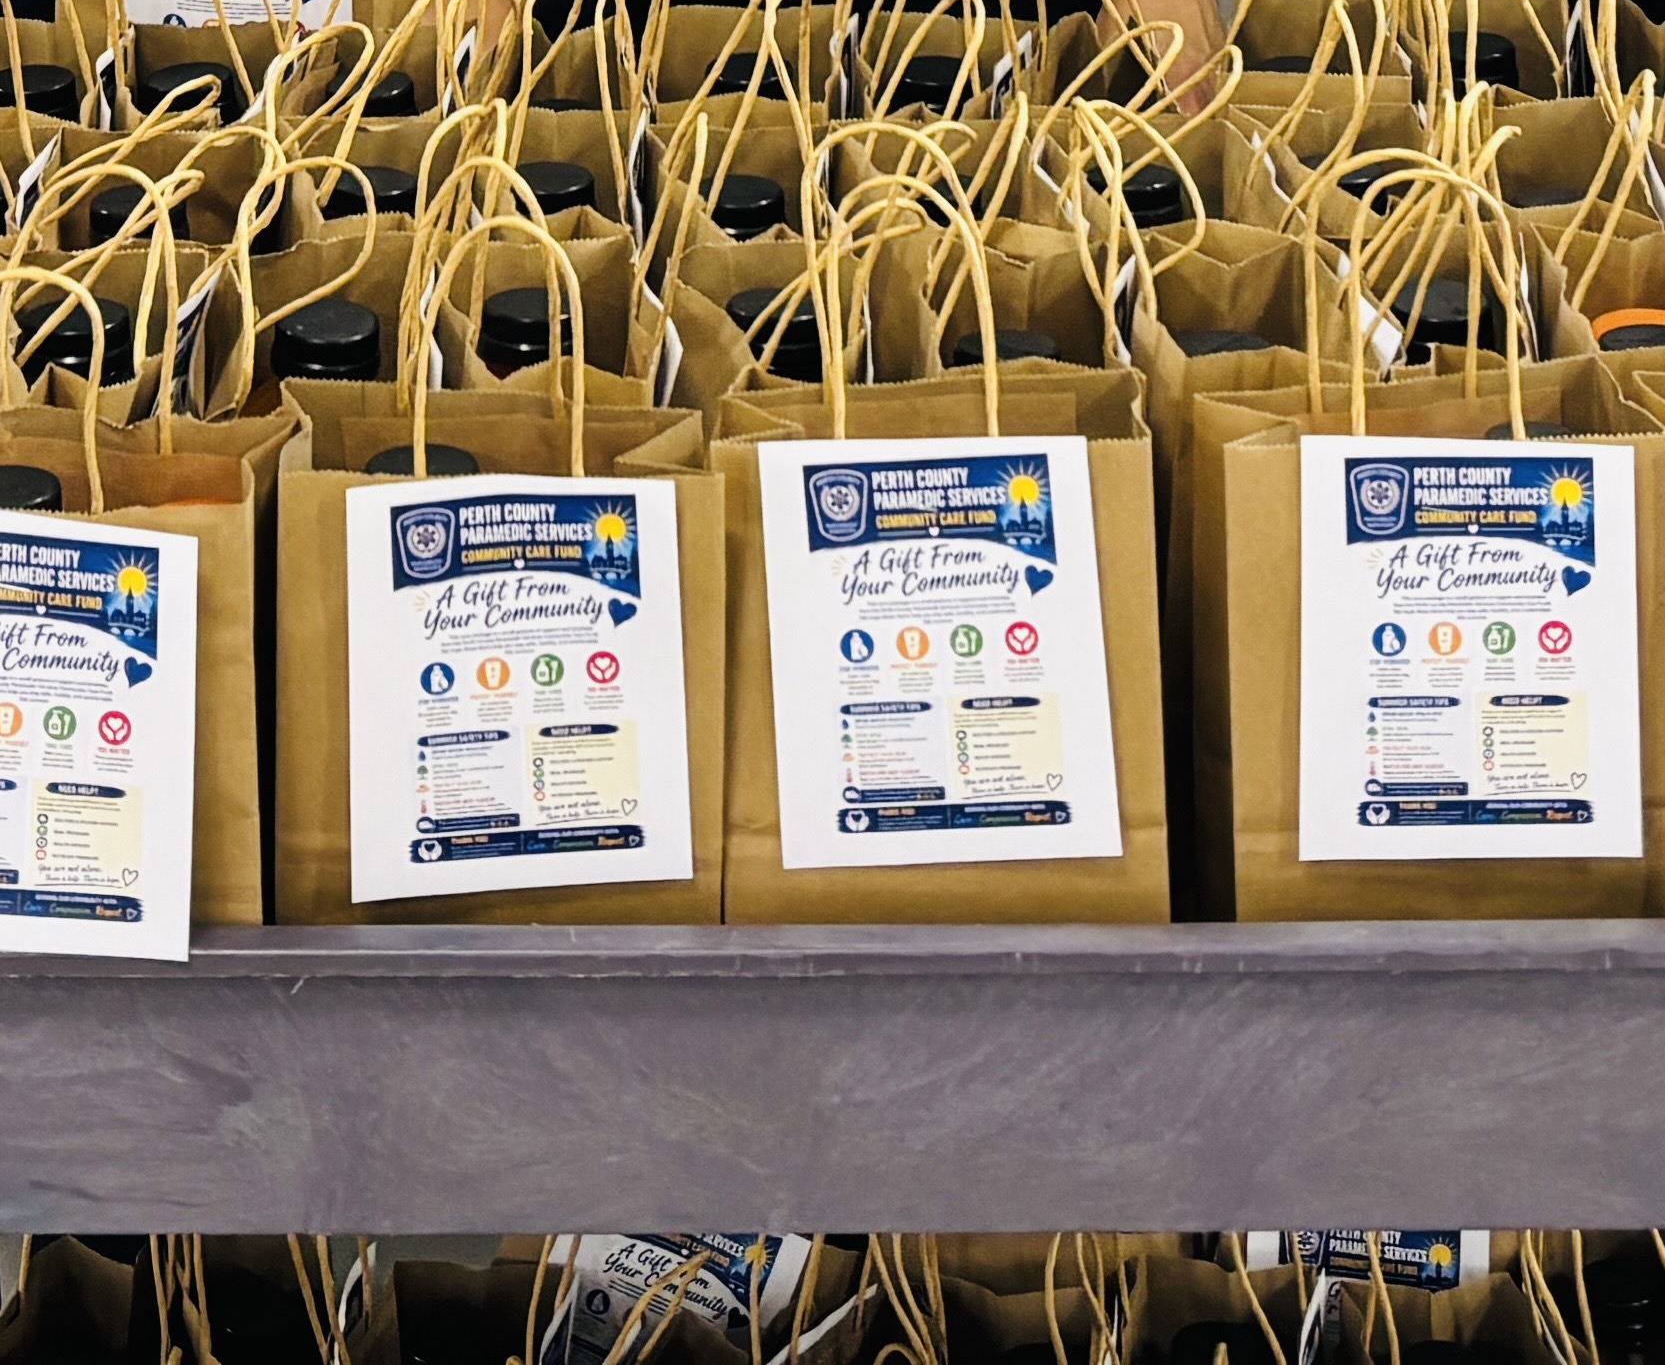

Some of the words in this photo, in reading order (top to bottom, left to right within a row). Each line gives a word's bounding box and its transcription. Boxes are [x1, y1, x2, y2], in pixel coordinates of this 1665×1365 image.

[872, 471, 914, 489] PERTH
[917, 467, 968, 487] COUNTY
[1414, 467, 1456, 485] PERTH
[1459, 468, 1511, 485] COUNTY
[874, 489, 945, 510] PARAMEDIC
[947, 486, 1007, 508] SERVICES
[1414, 487, 1486, 506] PARAMEDIC
[1489, 487, 1548, 506] SERVICES
[460, 504, 501, 526] PERTH
[504, 504, 555, 522] COUNTY
[460, 523, 533, 545] PARAMEDIC
[535, 523, 593, 542] SERVICES
[30, 546, 81, 569] COUNTY
[525, 545, 552, 560] CARE
[555, 544, 582, 559] FUND
[853, 550, 870, 574] A
[879, 546, 924, 576] Gift
[930, 544, 984, 567] From
[1389, 544, 1409, 569] A
[1416, 543, 1463, 570] Gift
[1469, 542, 1523, 564] From
[58, 572, 115, 592] SERVICES
[841, 574, 895, 606] Your
[901, 562, 1020, 597] Community
[1376, 568, 1430, 598] Your
[1437, 563, 1558, 592] Community
[47, 592, 73, 609] CARE
[76, 596, 103, 611] FUND
[436, 584, 455, 610] A
[464, 578, 509, 607] Gift
[516, 576, 570, 601] From
[424, 609, 477, 640] Your
[485, 595, 604, 629] Community
[36, 623, 87, 647] From
[2, 647, 121, 681] Community
[604, 1253, 644, 1278] Your
[618, 1243, 636, 1262] A
[637, 1245, 673, 1273] Gift
